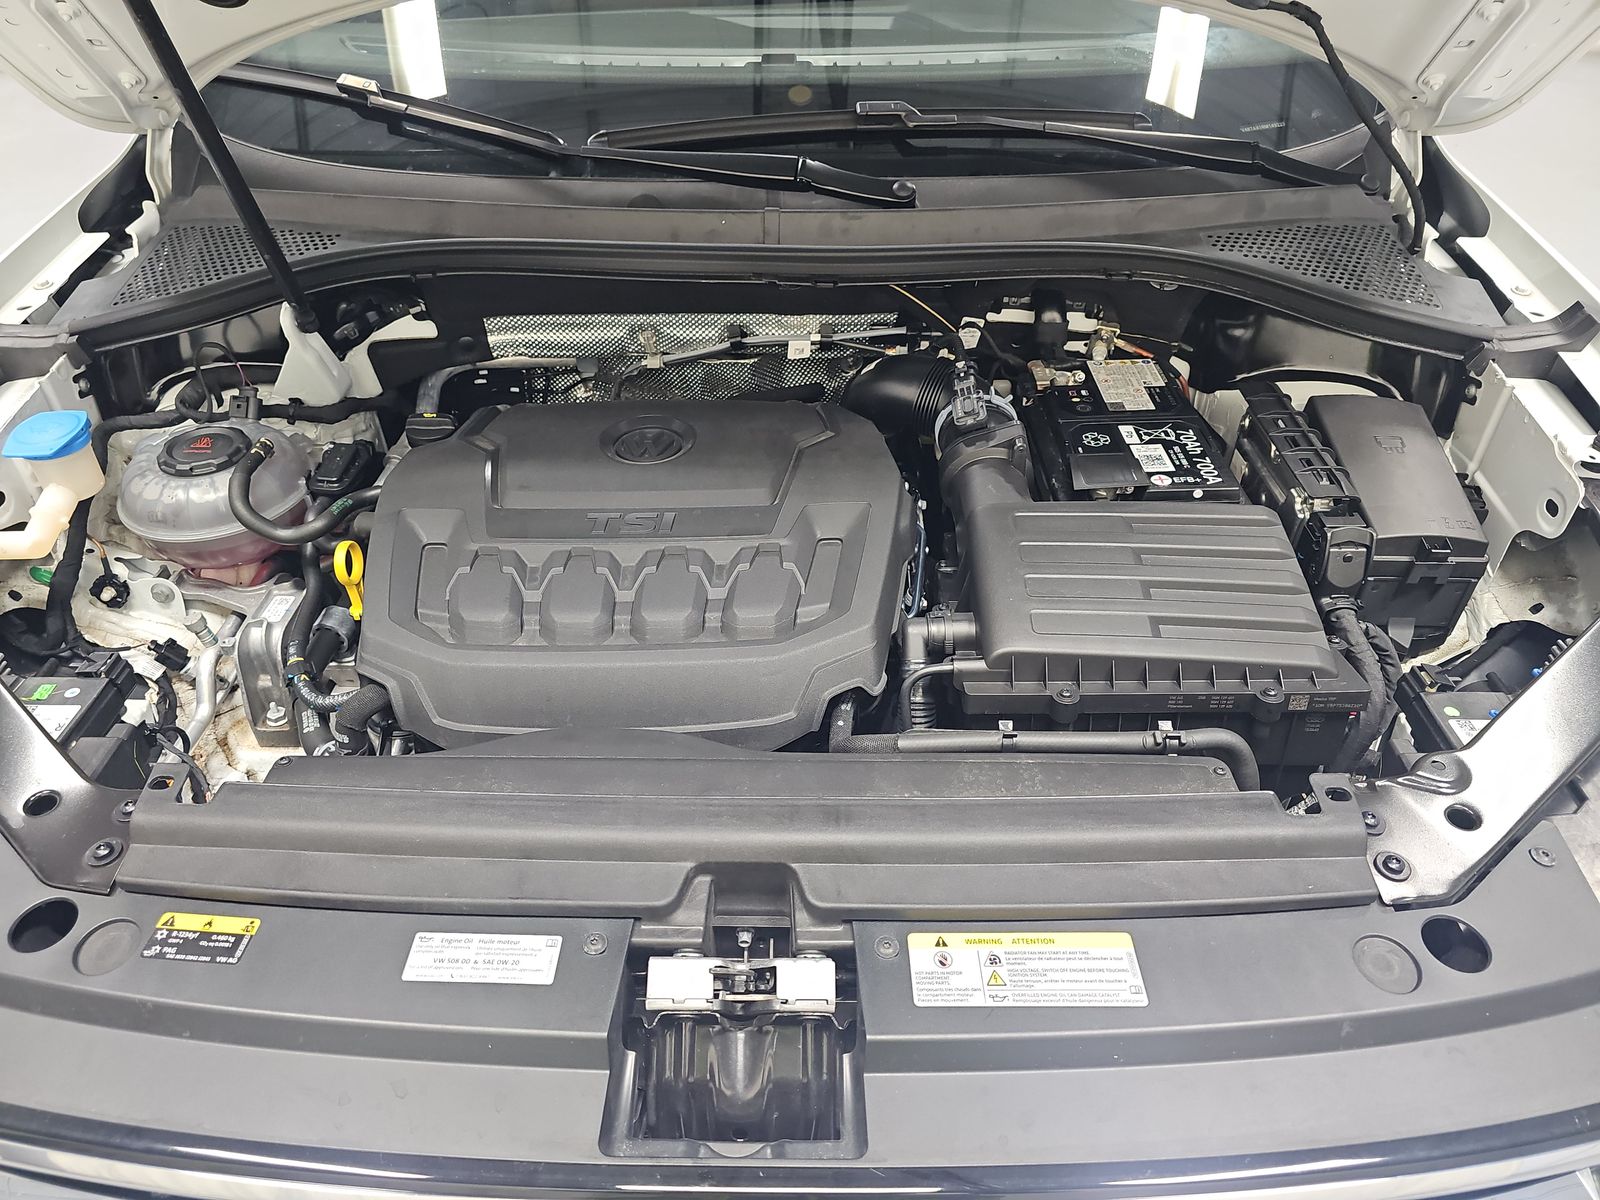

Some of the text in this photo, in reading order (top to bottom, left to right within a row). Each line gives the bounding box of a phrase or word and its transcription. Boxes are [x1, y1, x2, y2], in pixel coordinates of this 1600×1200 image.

[1176, 428, 1223, 485] 70Ah 700A
[585, 512, 678, 534] TSI
[171, 930, 200, 940] R-1234yf
